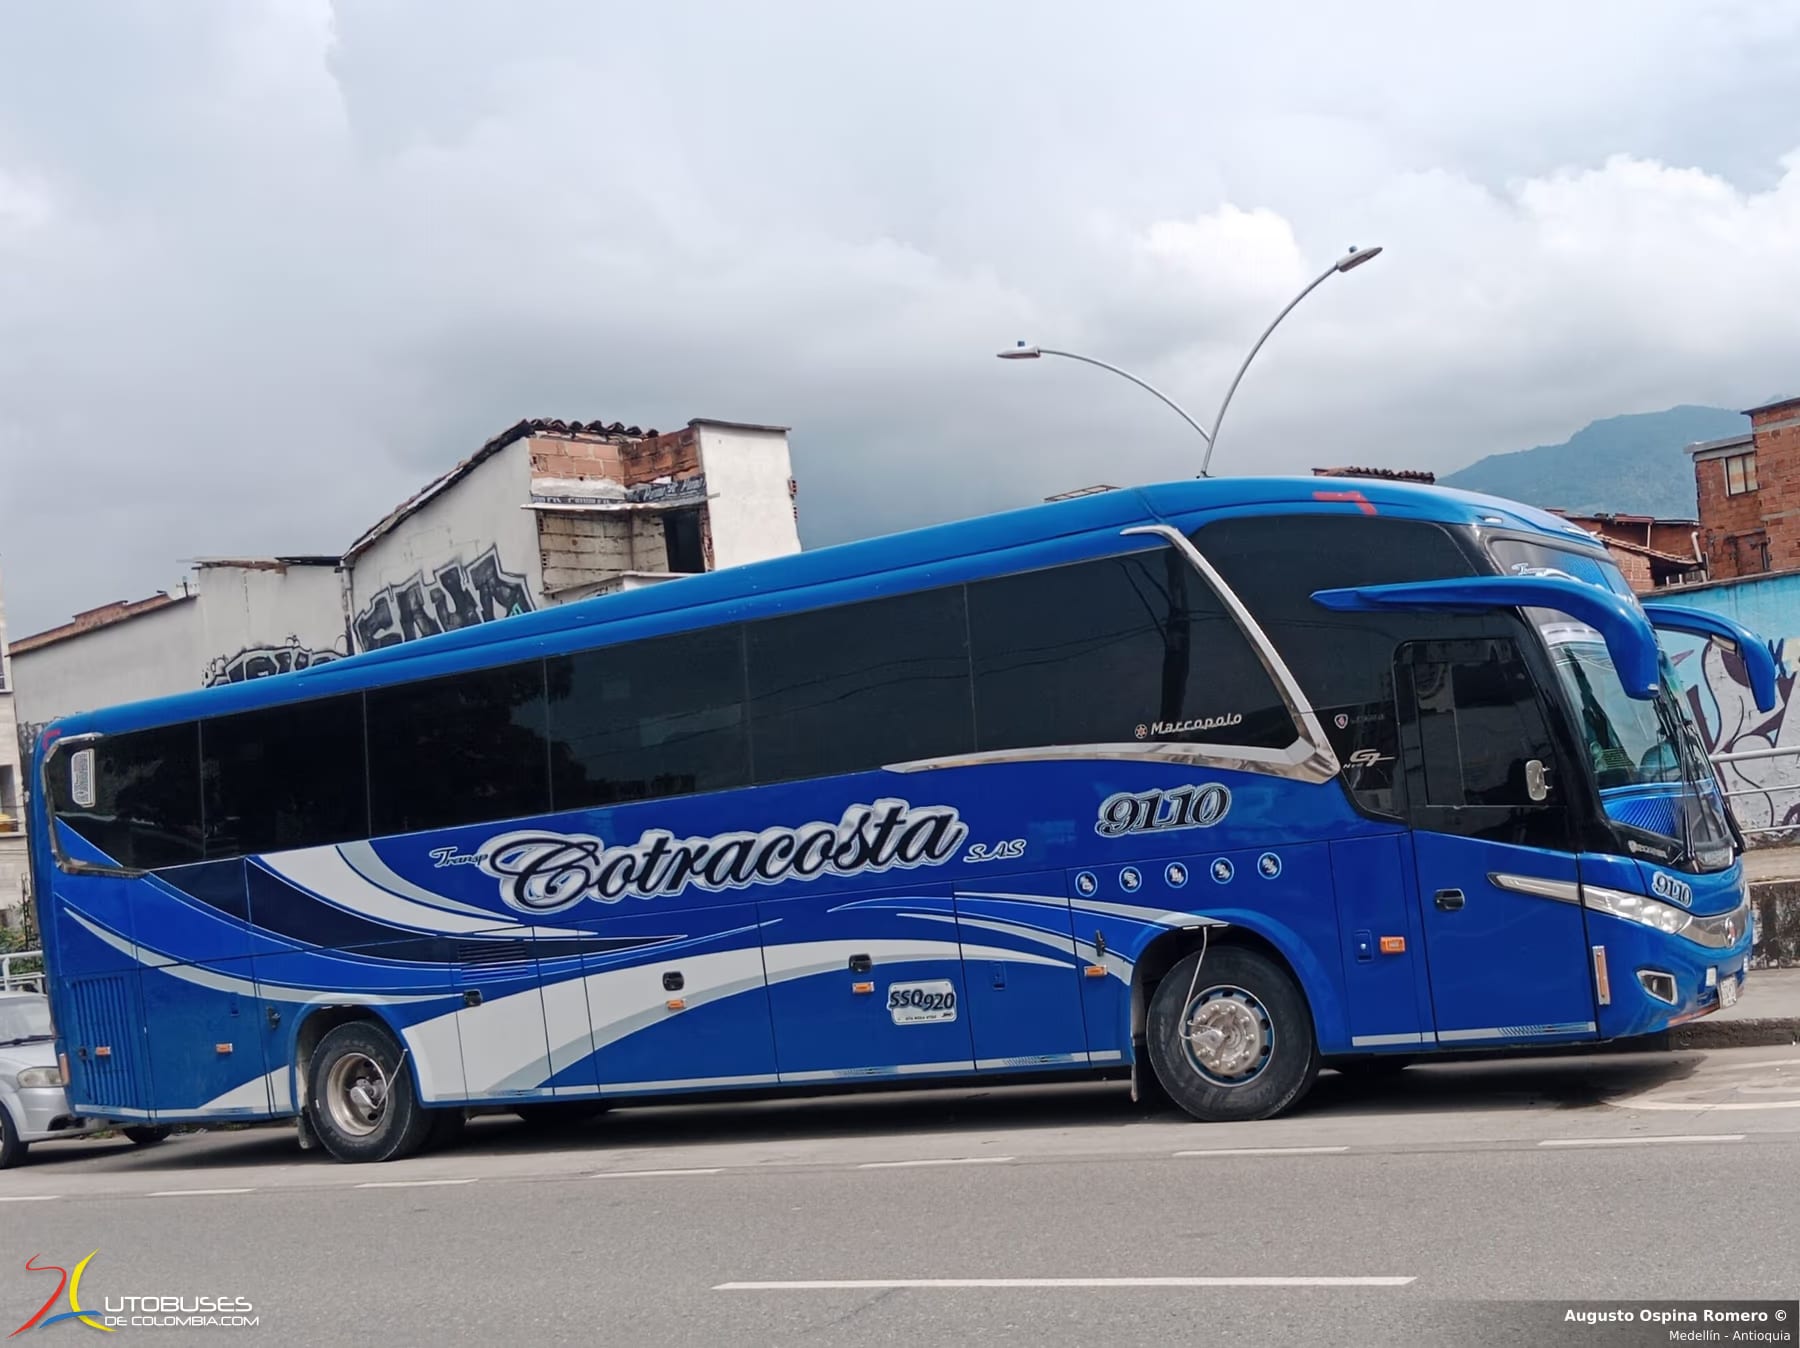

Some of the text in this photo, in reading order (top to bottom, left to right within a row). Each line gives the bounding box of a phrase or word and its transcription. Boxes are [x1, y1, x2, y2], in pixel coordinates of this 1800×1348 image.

[1150, 713, 1243, 735] Marcopolo
[1095, 782, 1232, 838] 9110
[429, 799, 1026, 914] Transp Cotracosta SAS
[1652, 871, 1692, 908] 9110
